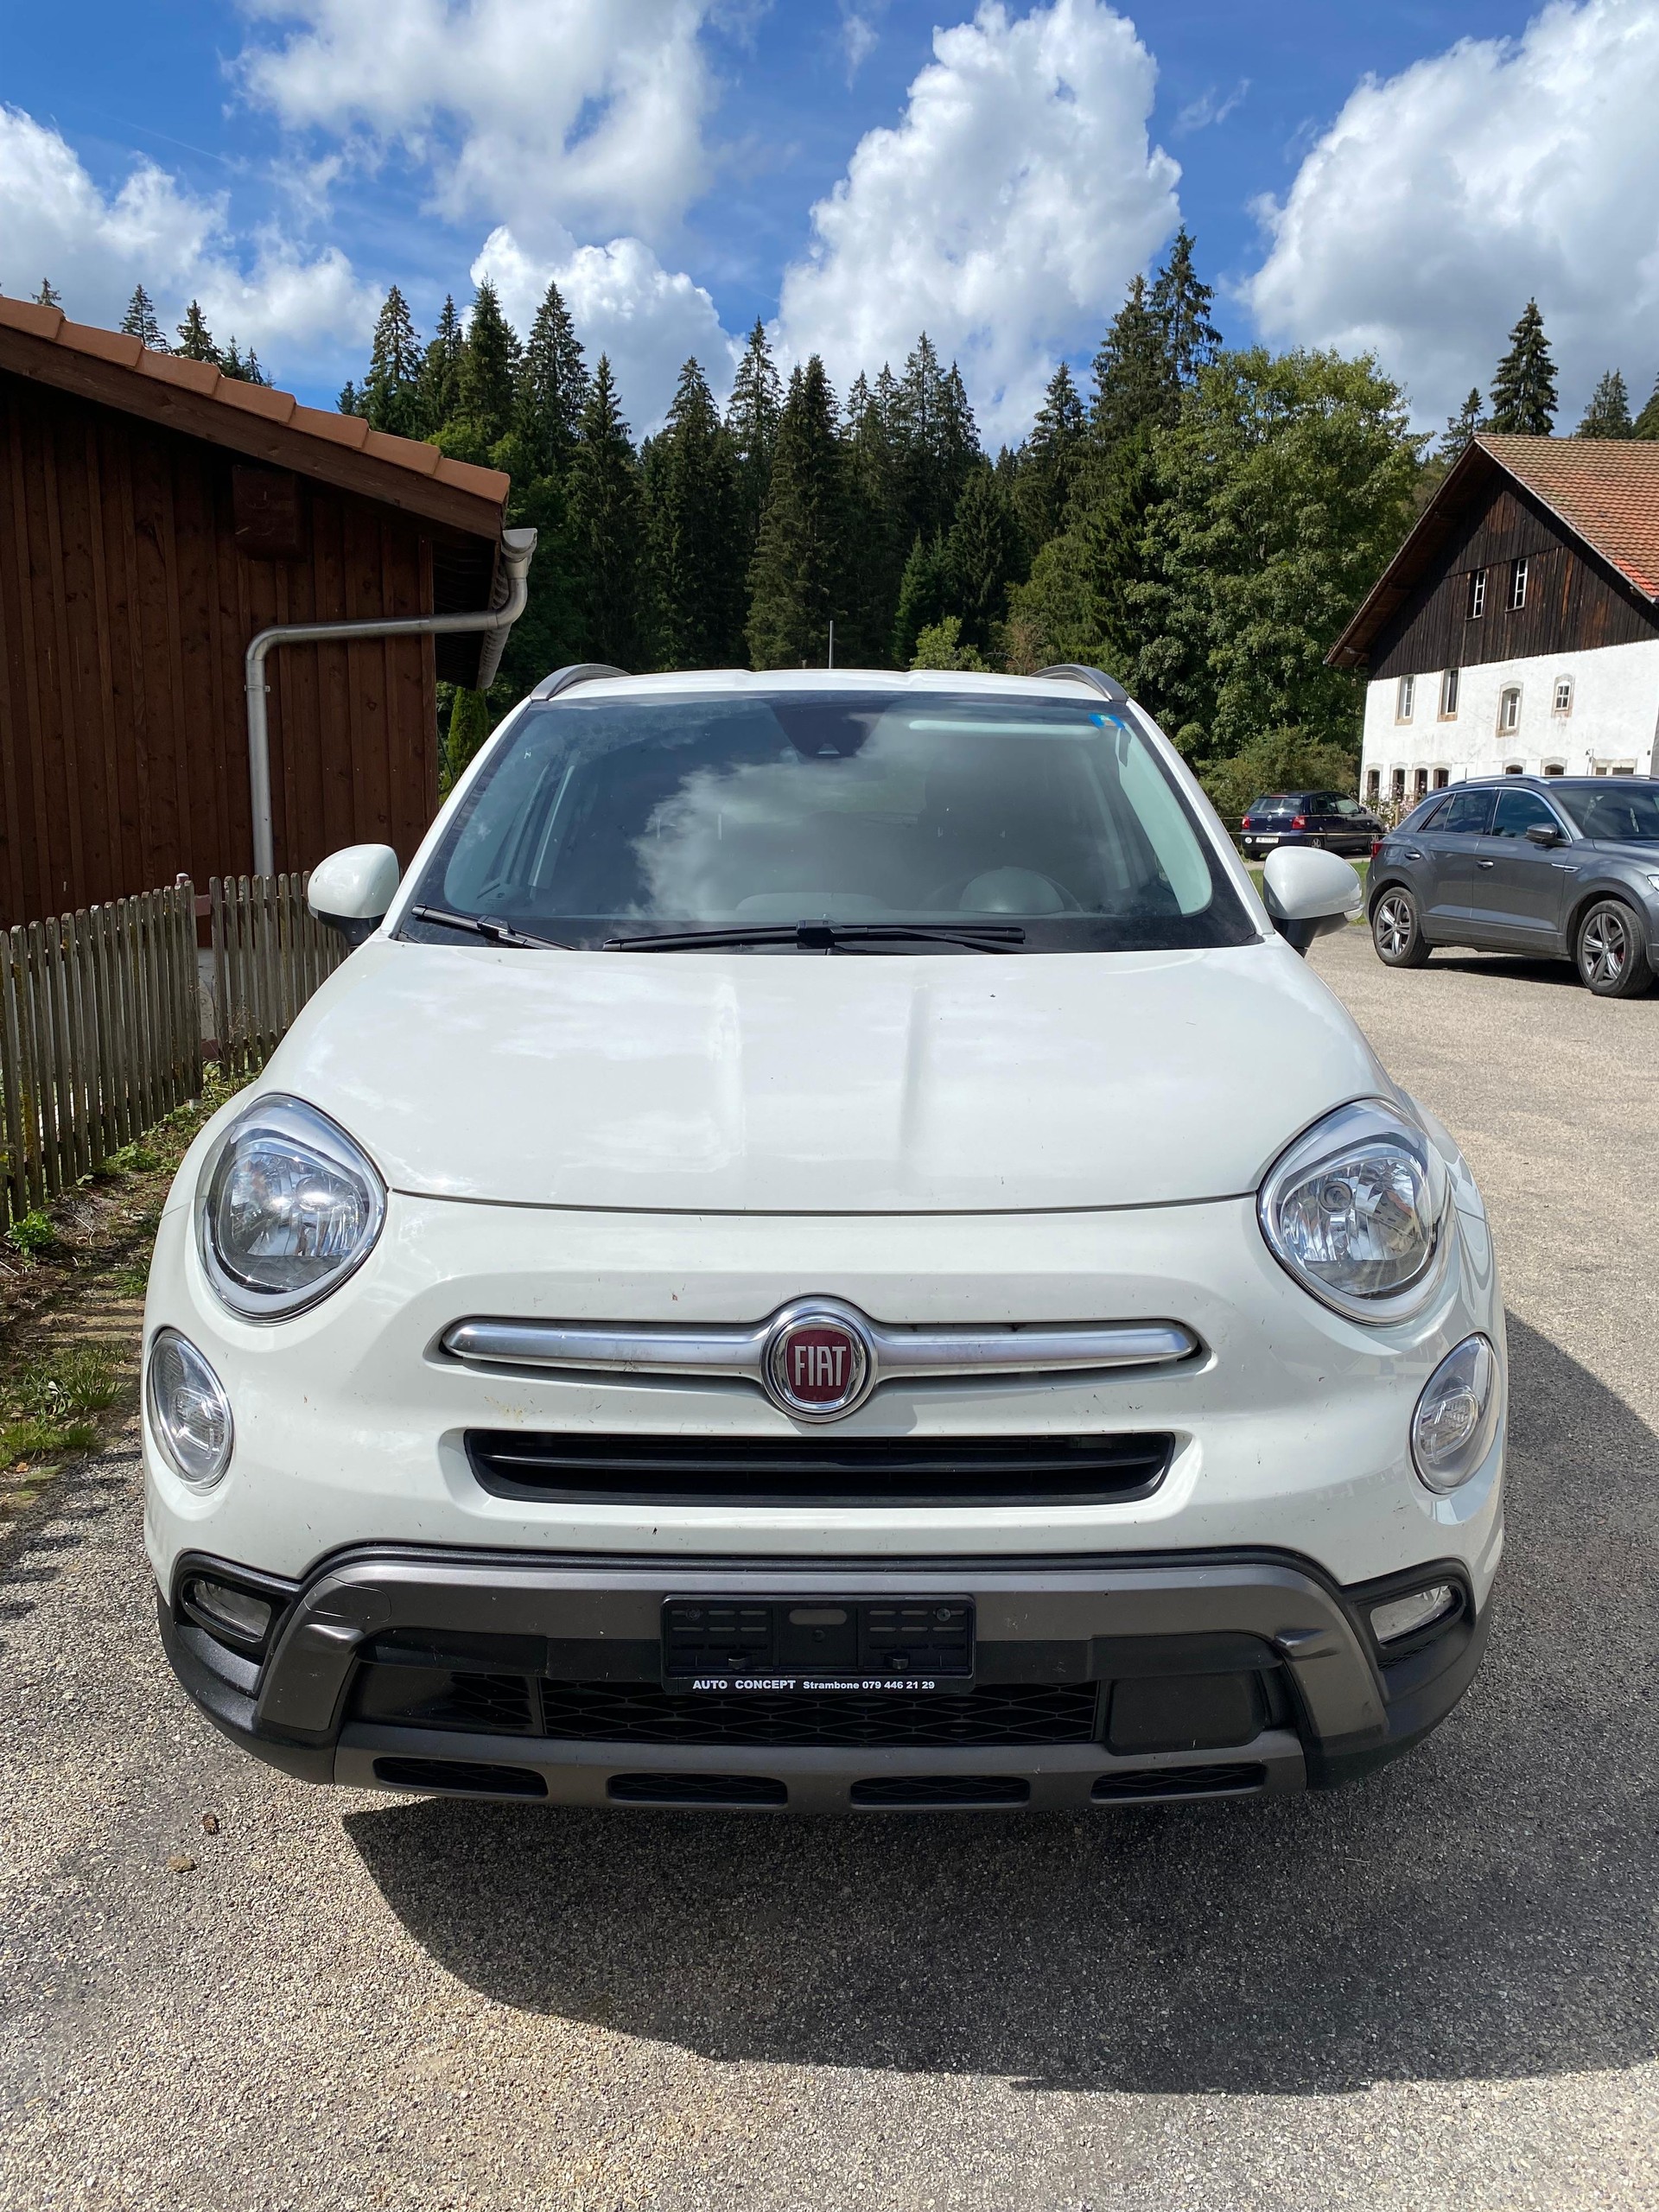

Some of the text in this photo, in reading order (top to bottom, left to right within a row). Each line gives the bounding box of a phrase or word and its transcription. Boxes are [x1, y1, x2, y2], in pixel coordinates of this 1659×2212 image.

[794, 1345, 847, 1386] FIAT
[692, 1680, 935, 1689] AUTO CONCEPT Strambone 079 446 21 29
